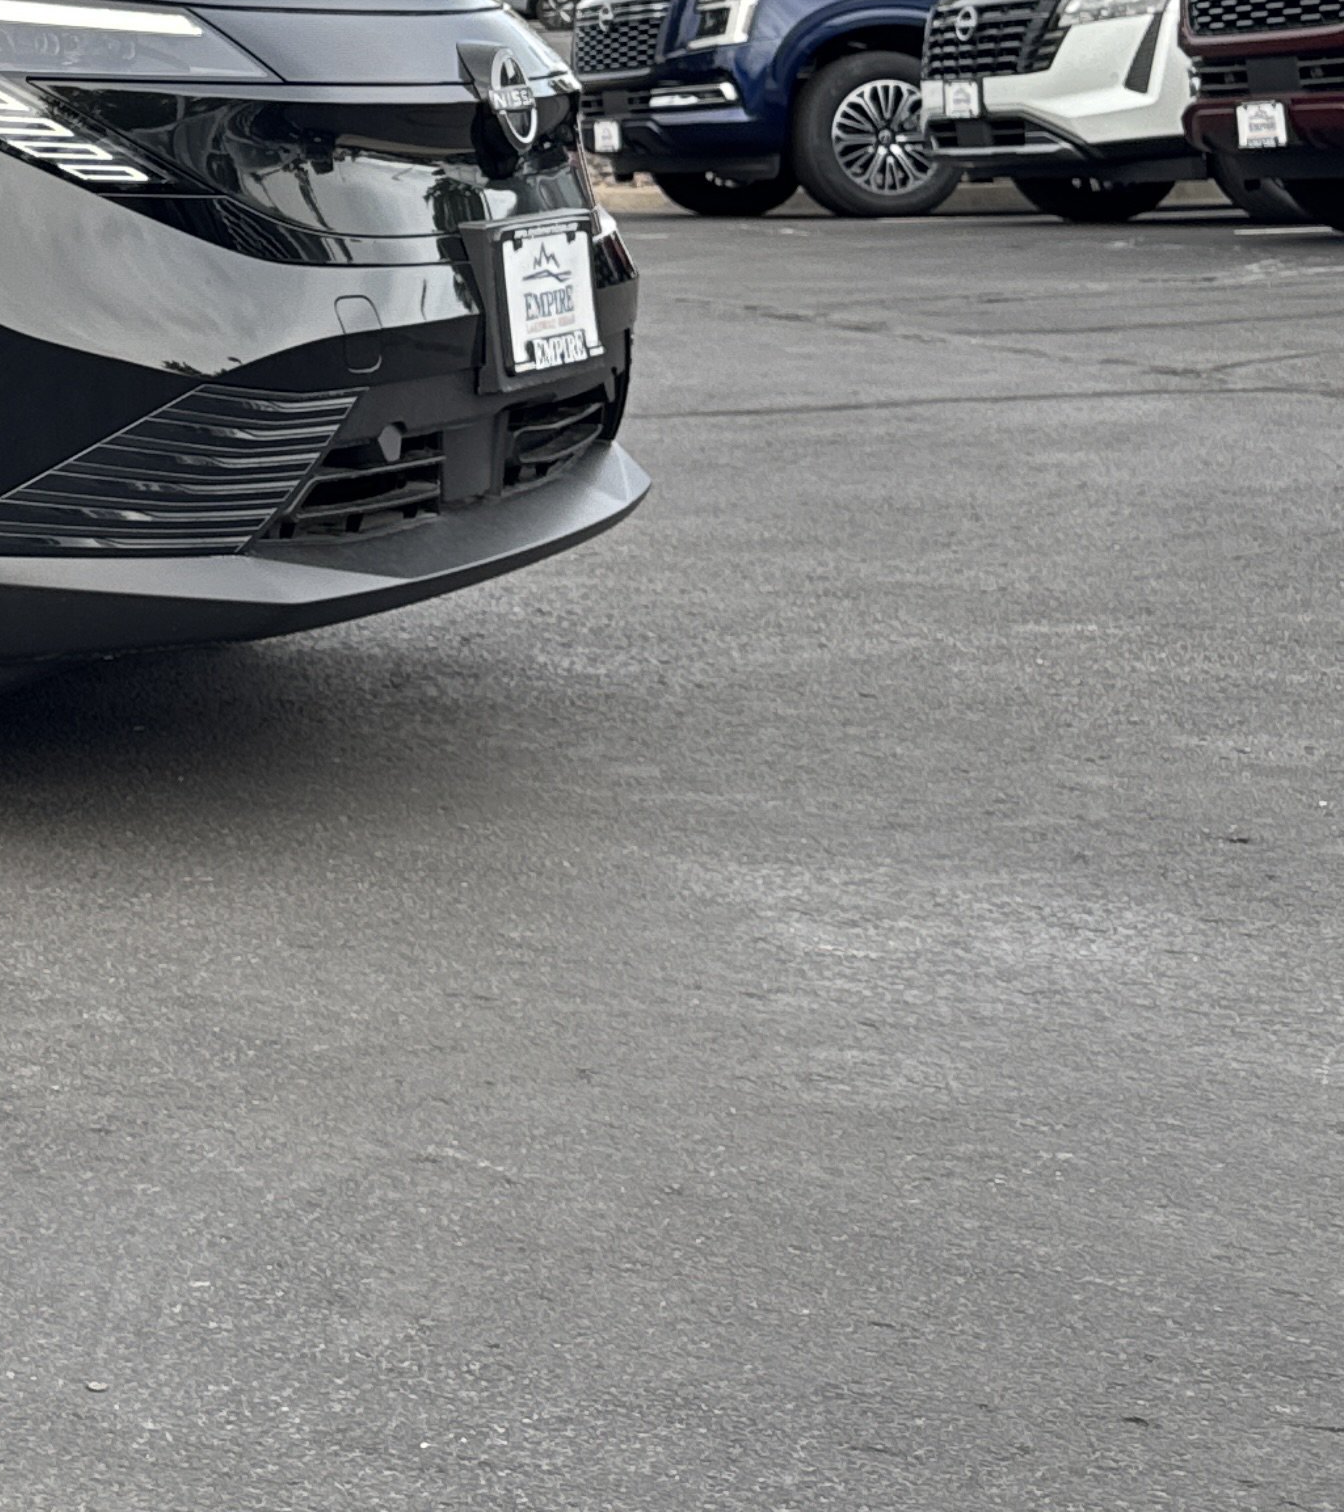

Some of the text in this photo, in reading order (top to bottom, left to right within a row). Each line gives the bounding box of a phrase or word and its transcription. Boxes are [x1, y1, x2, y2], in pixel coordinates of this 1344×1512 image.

[492, 89, 533, 110] NISS
[524, 285, 575, 320] EMPIRE
[533, 331, 588, 370] EMPIRE
